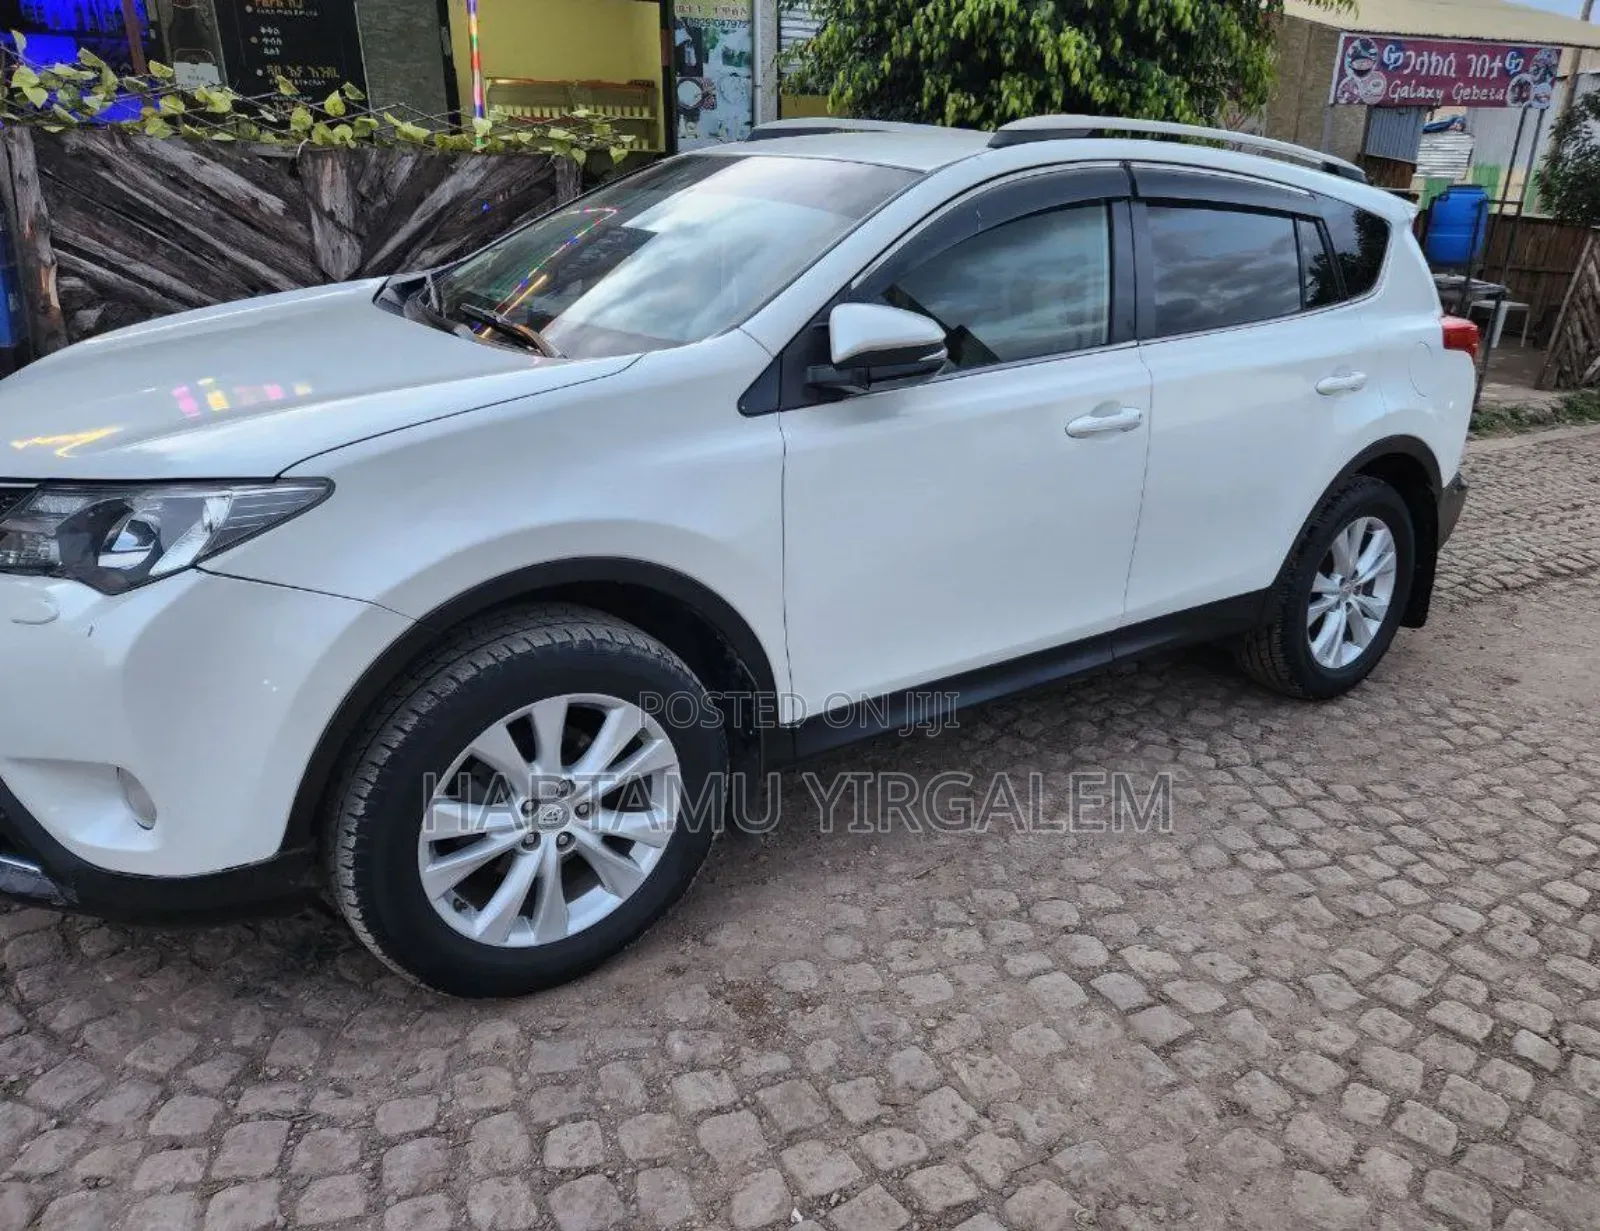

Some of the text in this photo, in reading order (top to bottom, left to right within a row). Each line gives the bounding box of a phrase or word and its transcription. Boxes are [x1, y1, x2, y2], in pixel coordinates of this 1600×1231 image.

[1403, 51, 1456, 78] ጋላክሲ
[1467, 53, 1503, 80] ገበታ
[1388, 79, 1445, 106] Galaxy
